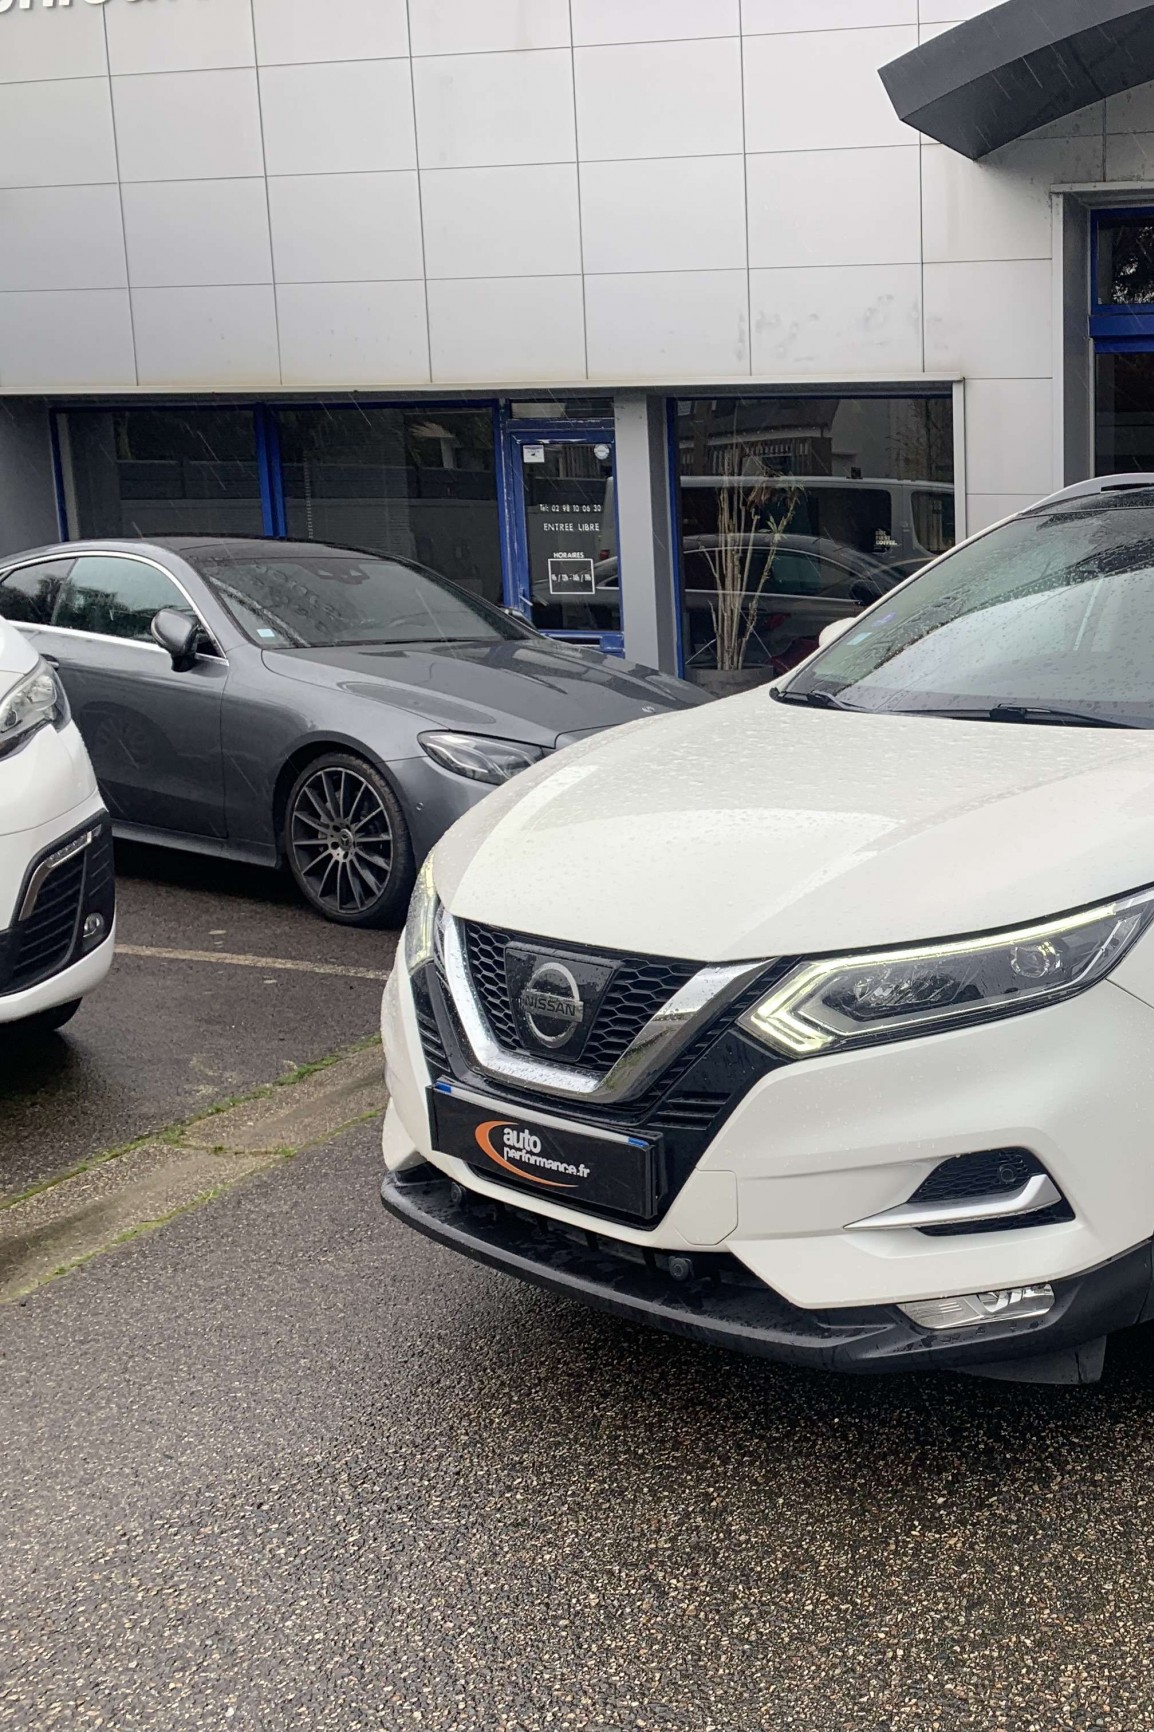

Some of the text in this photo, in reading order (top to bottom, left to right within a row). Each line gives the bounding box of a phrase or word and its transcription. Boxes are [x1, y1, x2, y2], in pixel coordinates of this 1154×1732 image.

[577, 523, 600, 531] LIBRE
[524, 995, 576, 1017] NISSAN
[503, 1128, 542, 1154] auto
